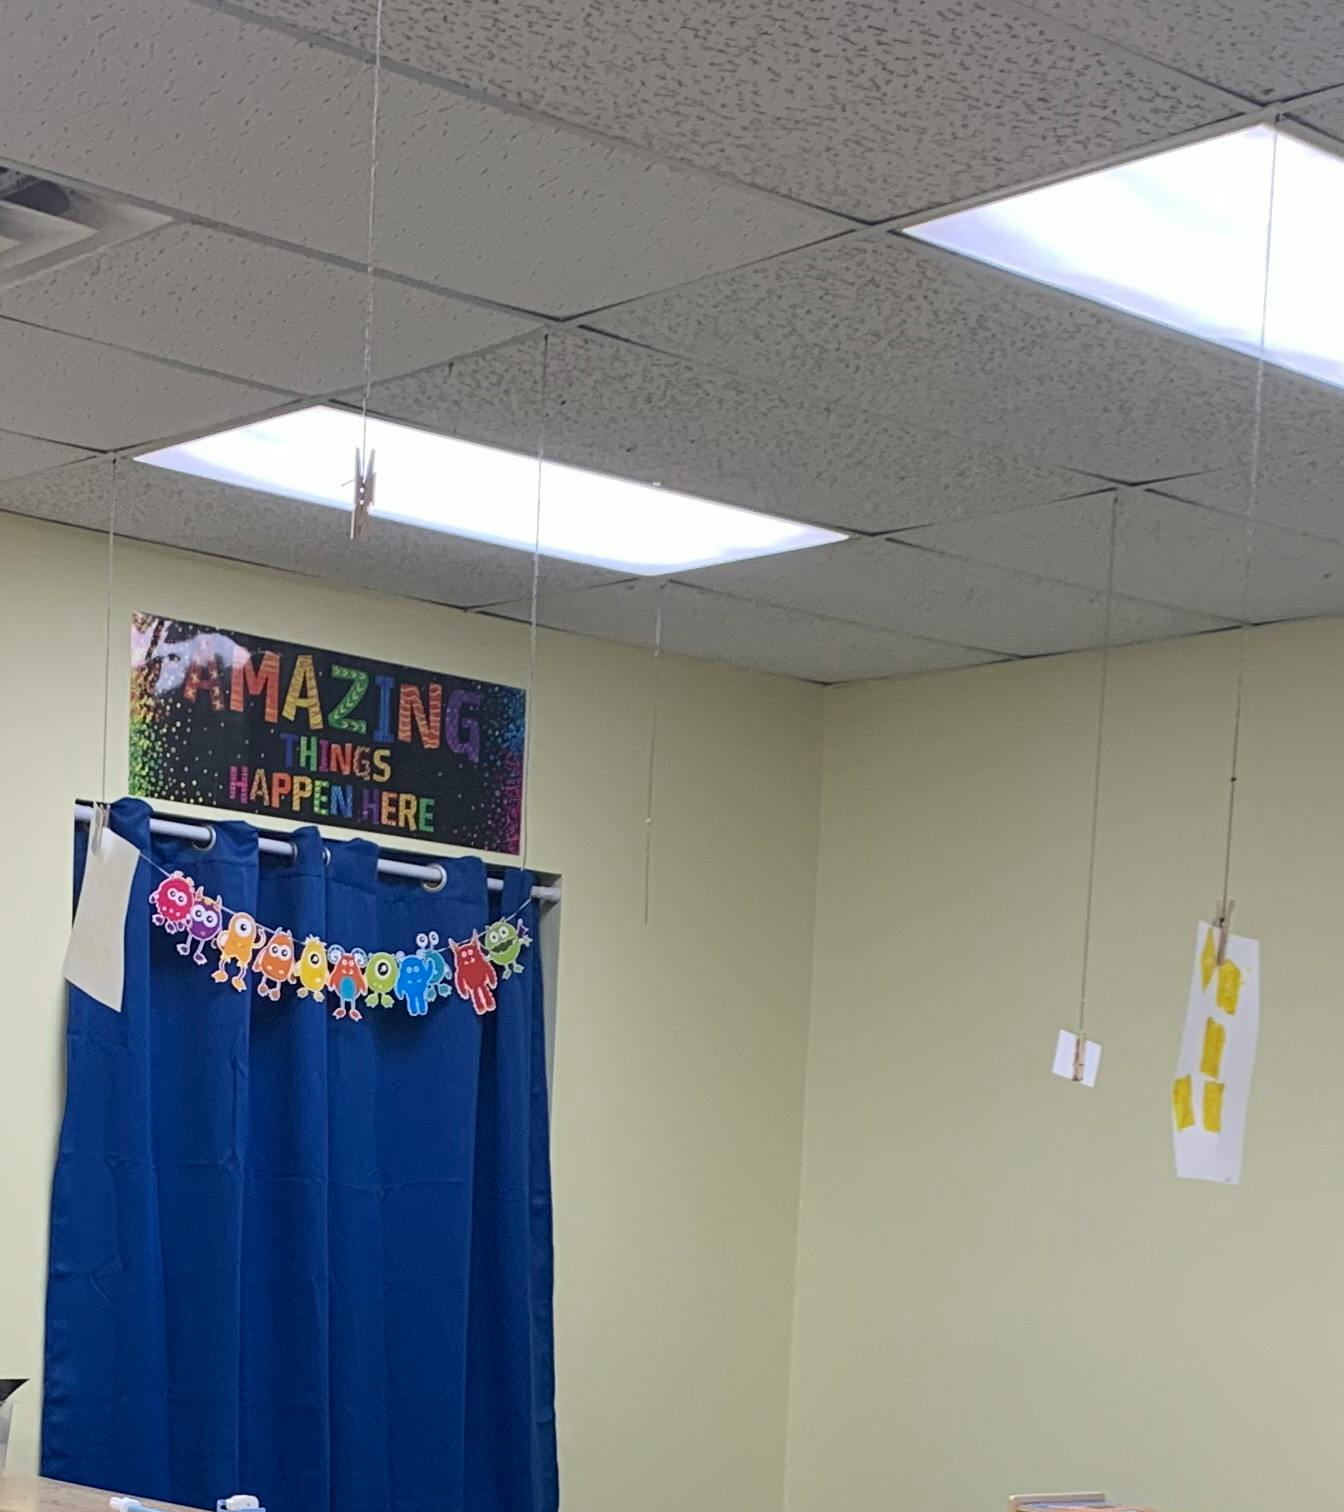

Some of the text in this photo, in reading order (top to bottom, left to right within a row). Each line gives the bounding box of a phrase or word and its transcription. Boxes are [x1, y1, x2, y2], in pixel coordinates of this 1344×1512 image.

[183, 650, 485, 763] AMAZING
[280, 732, 391, 783] THINGS
[229, 765, 436, 832] HAPPEN HERE
